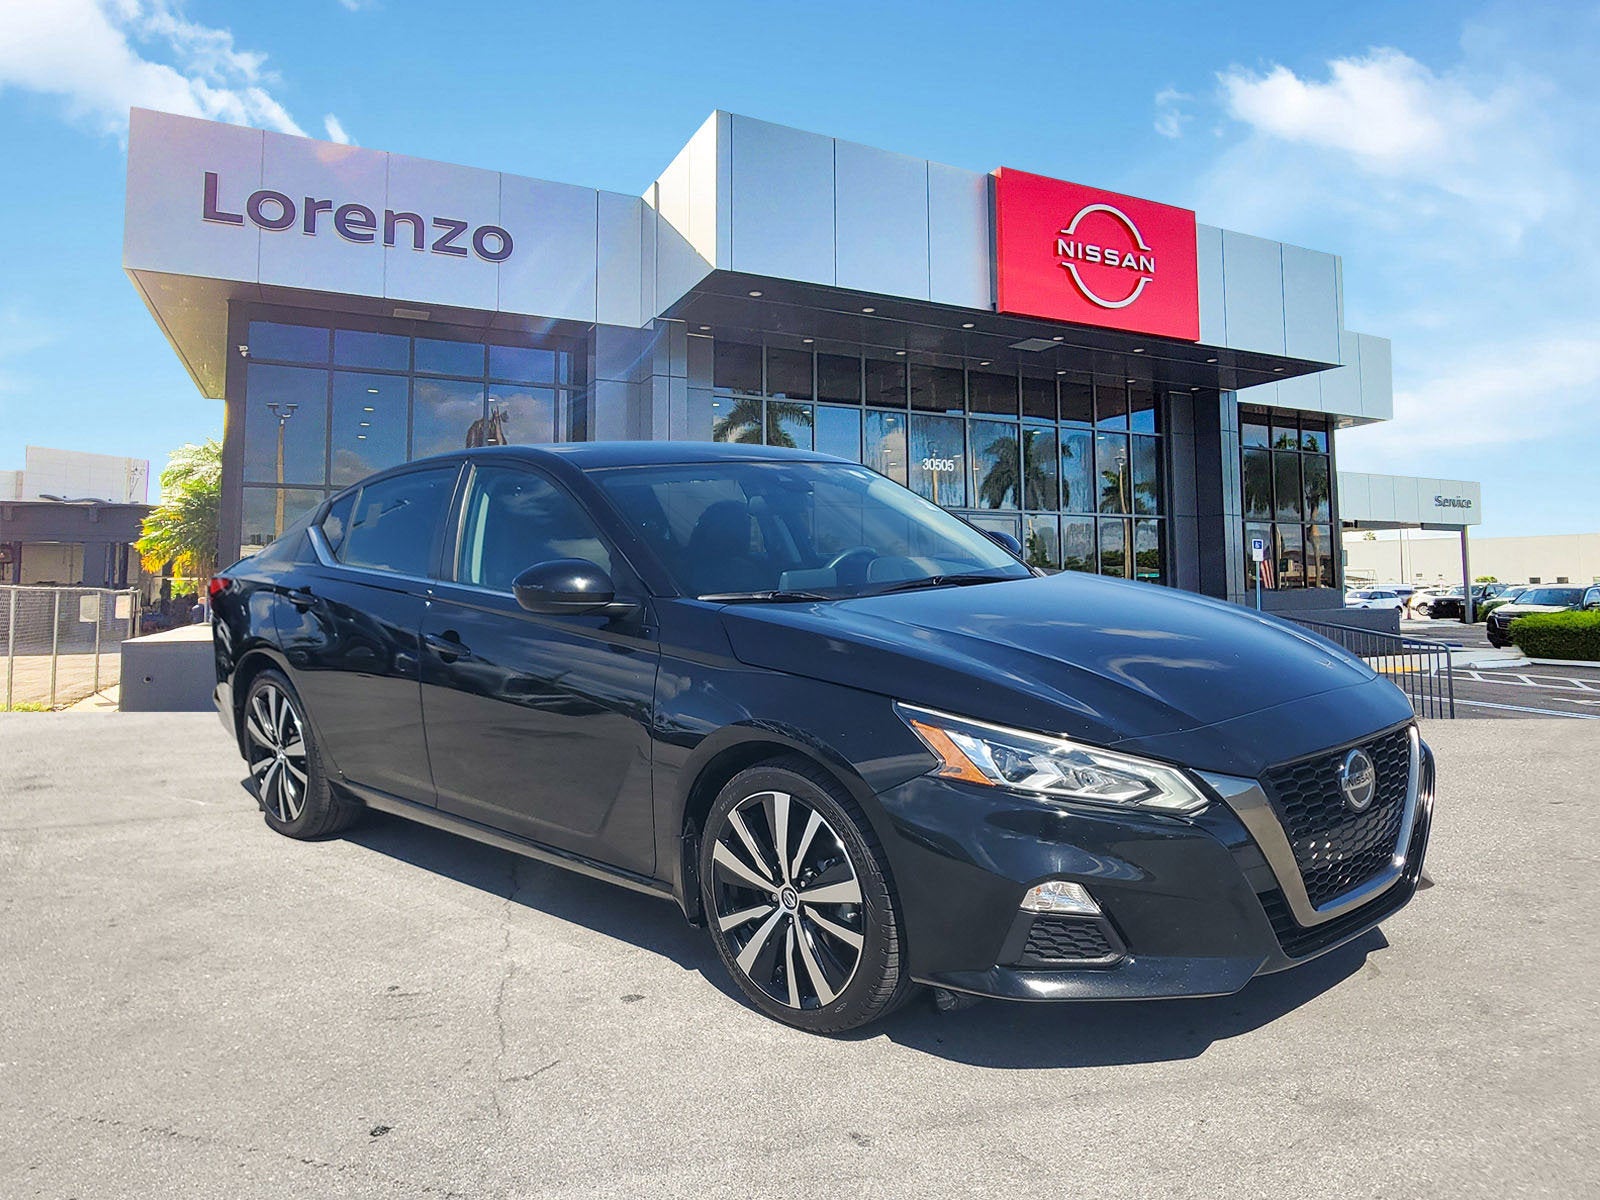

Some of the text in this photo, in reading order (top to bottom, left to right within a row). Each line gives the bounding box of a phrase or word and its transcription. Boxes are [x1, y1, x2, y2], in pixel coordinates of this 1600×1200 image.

[202, 171, 513, 262] Lorenzo
[1057, 238, 1155, 273] NISSAN
[922, 457, 955, 472] 30505
[1434, 495, 1472, 509] Service
